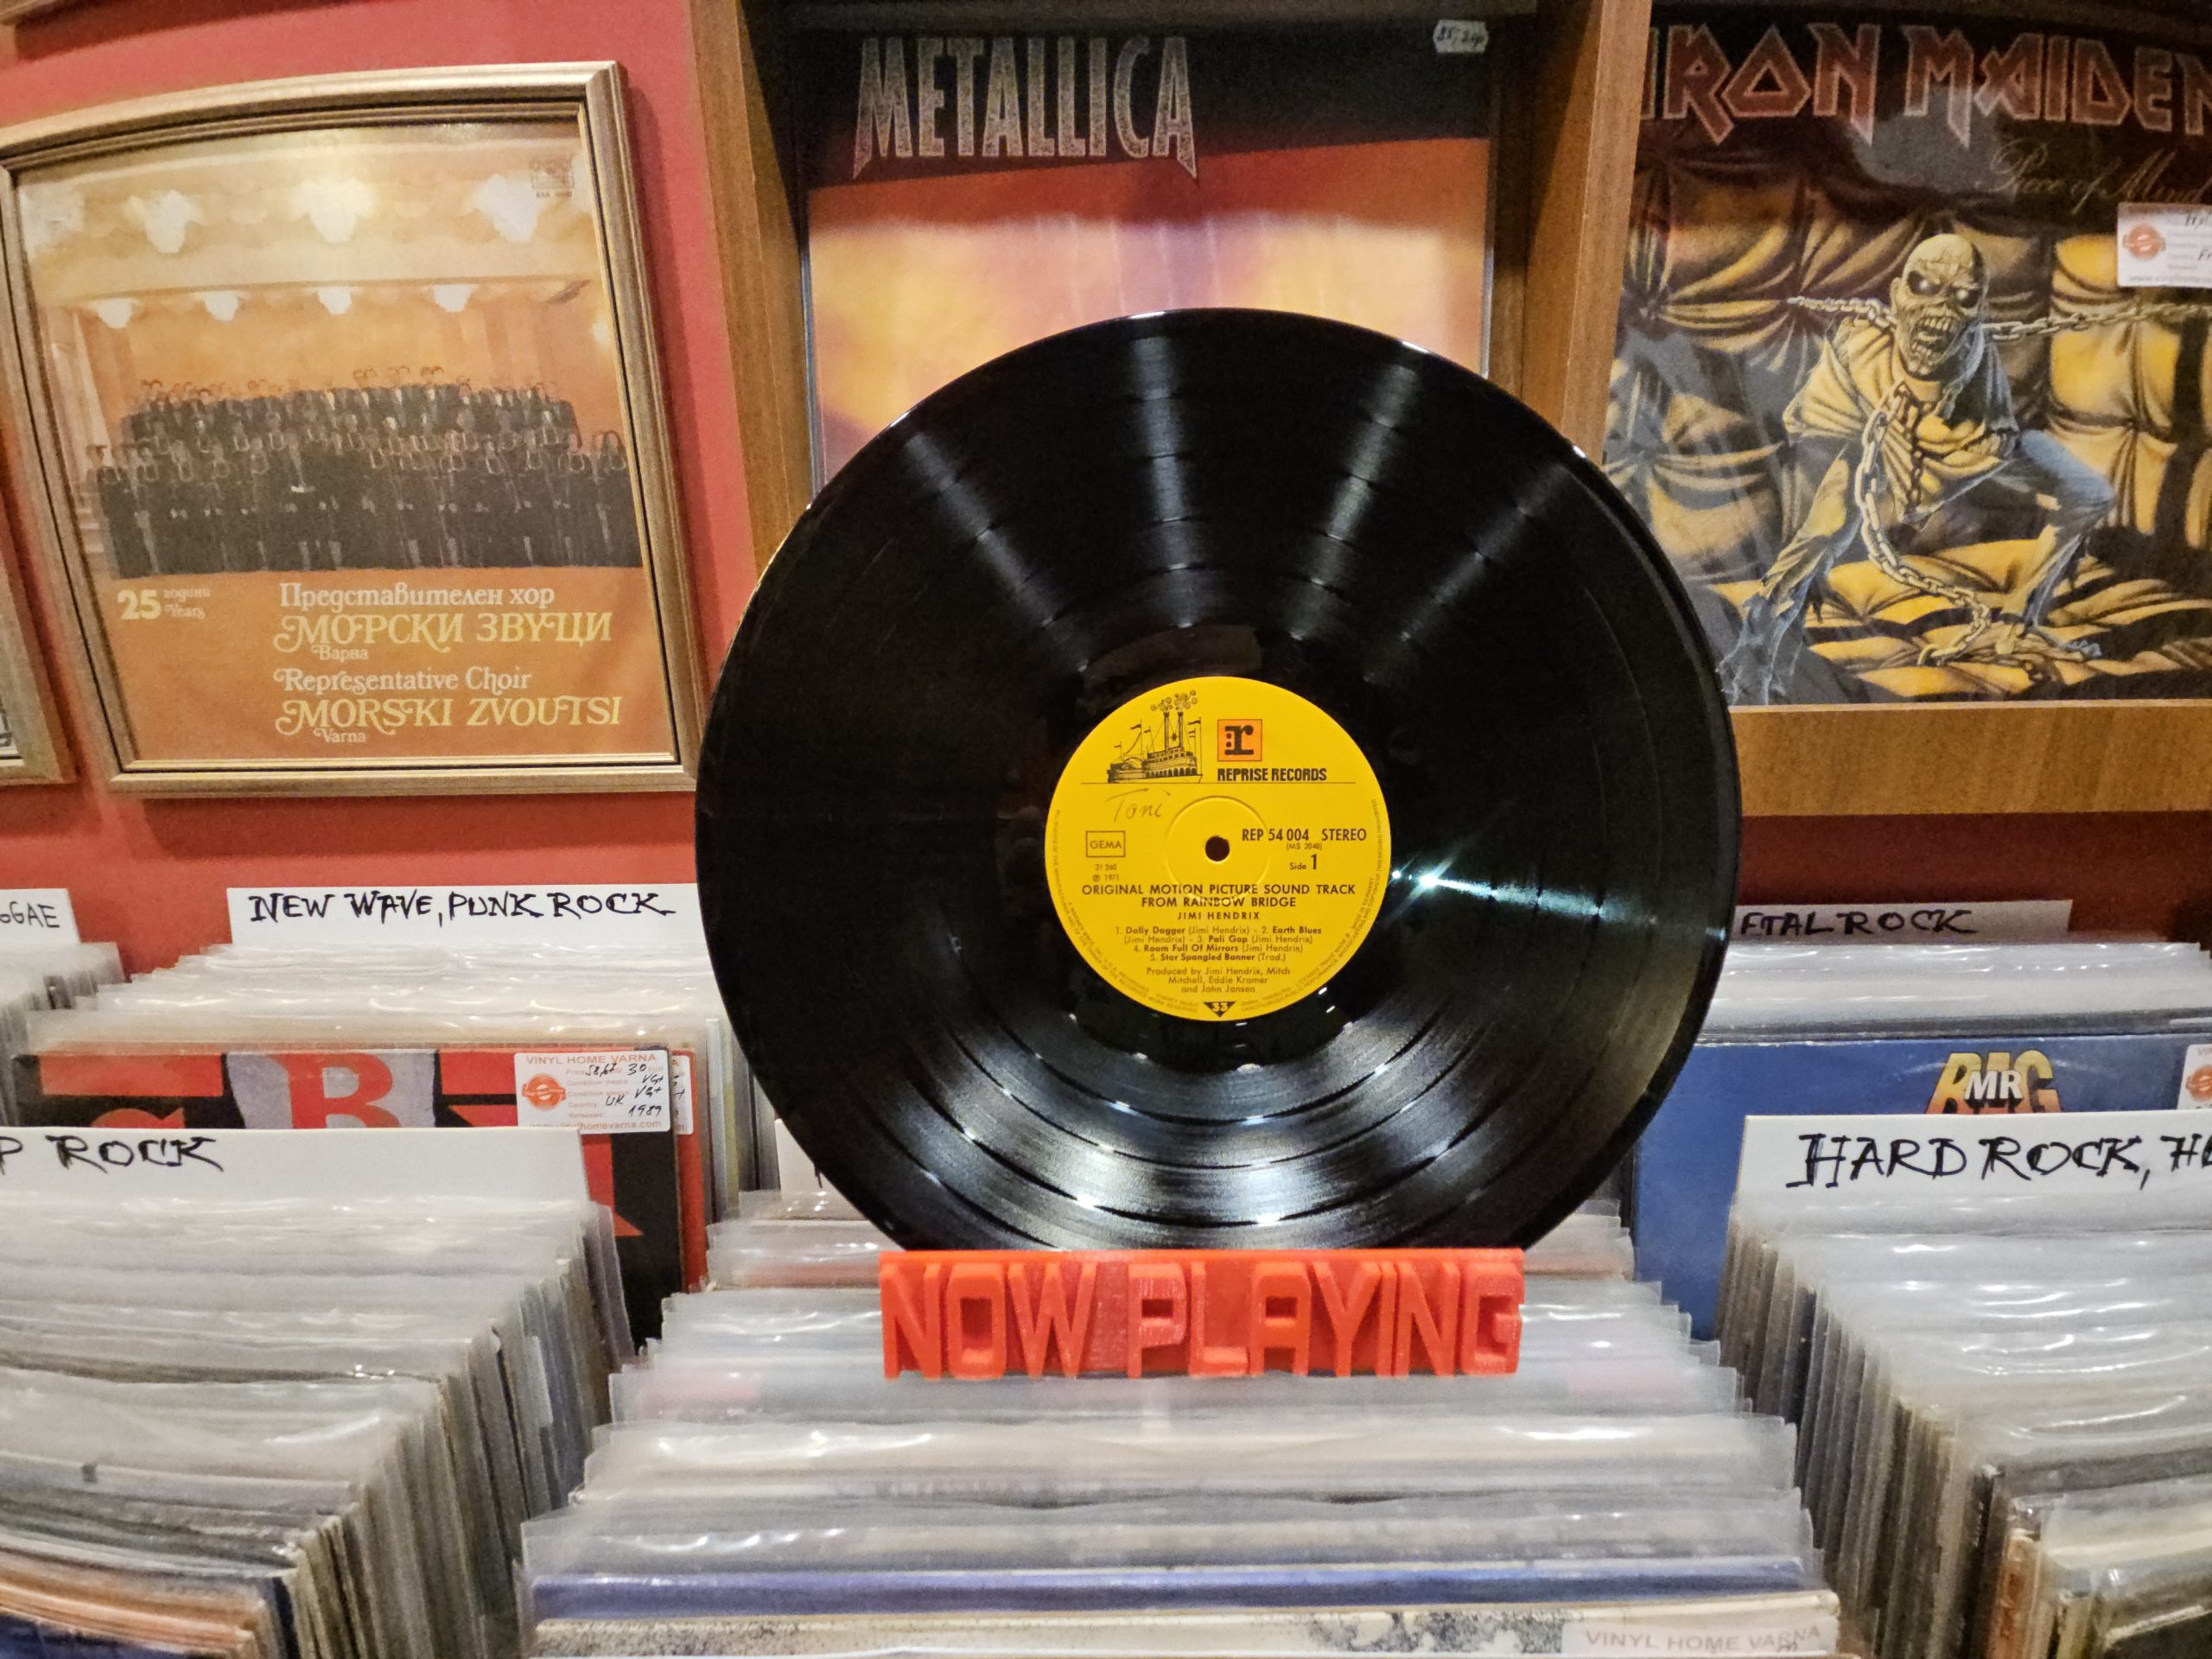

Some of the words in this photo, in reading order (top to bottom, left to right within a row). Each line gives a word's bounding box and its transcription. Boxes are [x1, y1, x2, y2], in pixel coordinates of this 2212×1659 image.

[1639, 22, 1881, 146] IRON
[854, 37, 1198, 179] METALLICA
[118, 589, 162, 620] 25
[279, 582, 505, 612] Представителен
[509, 585, 555, 610] хор
[164, 604, 207, 620] Years
[273, 612, 465, 653] МОРСКИ
[477, 611, 613, 647] ЗВУЦИ
[311, 643, 369, 663] Варна
[273, 668, 458, 696] Representative
[465, 665, 532, 696] Choir
[275, 697, 452, 735] MORSKI
[467, 696, 621, 727] ZVOUTSI
[314, 727, 367, 744] Varna
[1217, 768, 1268, 781] REPRISE
[1271, 768, 1327, 781] RECORDS
[1242, 829, 1264, 842] REP
[1321, 829, 1367, 842] STEREO
[1090, 840, 1122, 849] GEMA
[1311, 853, 1318, 870] 1
[1082, 885, 1144, 895] ORIGINAL
[1150, 884, 1204, 894] MOTION
[1210, 884, 1258, 894] PICTURE
[1264, 884, 1310, 894] SOUND
[1316, 884, 1356, 894] TRACK
[248, 893, 335, 924] NEW
[448, 890, 543, 921] PUNK
[548, 892, 677, 920] ROCK
[1141, 897, 1177, 907] FROM
[1183, 897, 1245, 907] RAINBOW
[1251, 897, 1296, 907] BRIDGE
[1178, 912, 1202, 920] JIMI
[1207, 912, 1260, 920] HENDRIX
[1740, 911, 1834, 937] ETAL
[1836, 909, 1978, 936] ROCK
[1126, 926, 1149, 935] Dolly
[1153, 926, 1185, 935] Dagger
[1213, 925, 1249, 935] Hendrix)
[1148, 935, 1185, 944] Hendrix)
[1229, 935, 1248, 944] Gap
[1275, 935, 1313, 944] Hendrix)
[1266, 944, 1303, 953] Hendrix)
[1181, 953, 1222, 962] Spangled
[1191, 968, 1202, 976] by
[1211, 1002, 1229, 1012] 33
[526, 1056, 563, 1065] VINYL
[567, 1055, 605, 1064] HOME
[609, 1054, 658, 1064] VARNA
[627, 1064, 646, 1076] 30
[1964, 1070, 2024, 1101] MR
[606, 1095, 626, 1106] UK
[628, 1104, 662, 1118] 1989
[45, 1134, 224, 1174] ROCK
[1785, 1132, 1967, 1189] HARD
[1979, 1135, 2151, 1191] ROCK,
[880, 1262, 1096, 1378] NOW
[1128, 1262, 1523, 1378] PLAYING
[1586, 1630, 1657, 1649] VINYL
[1668, 1635, 1740, 1651] HOME
[1748, 1625, 1821, 1649] VARNA
